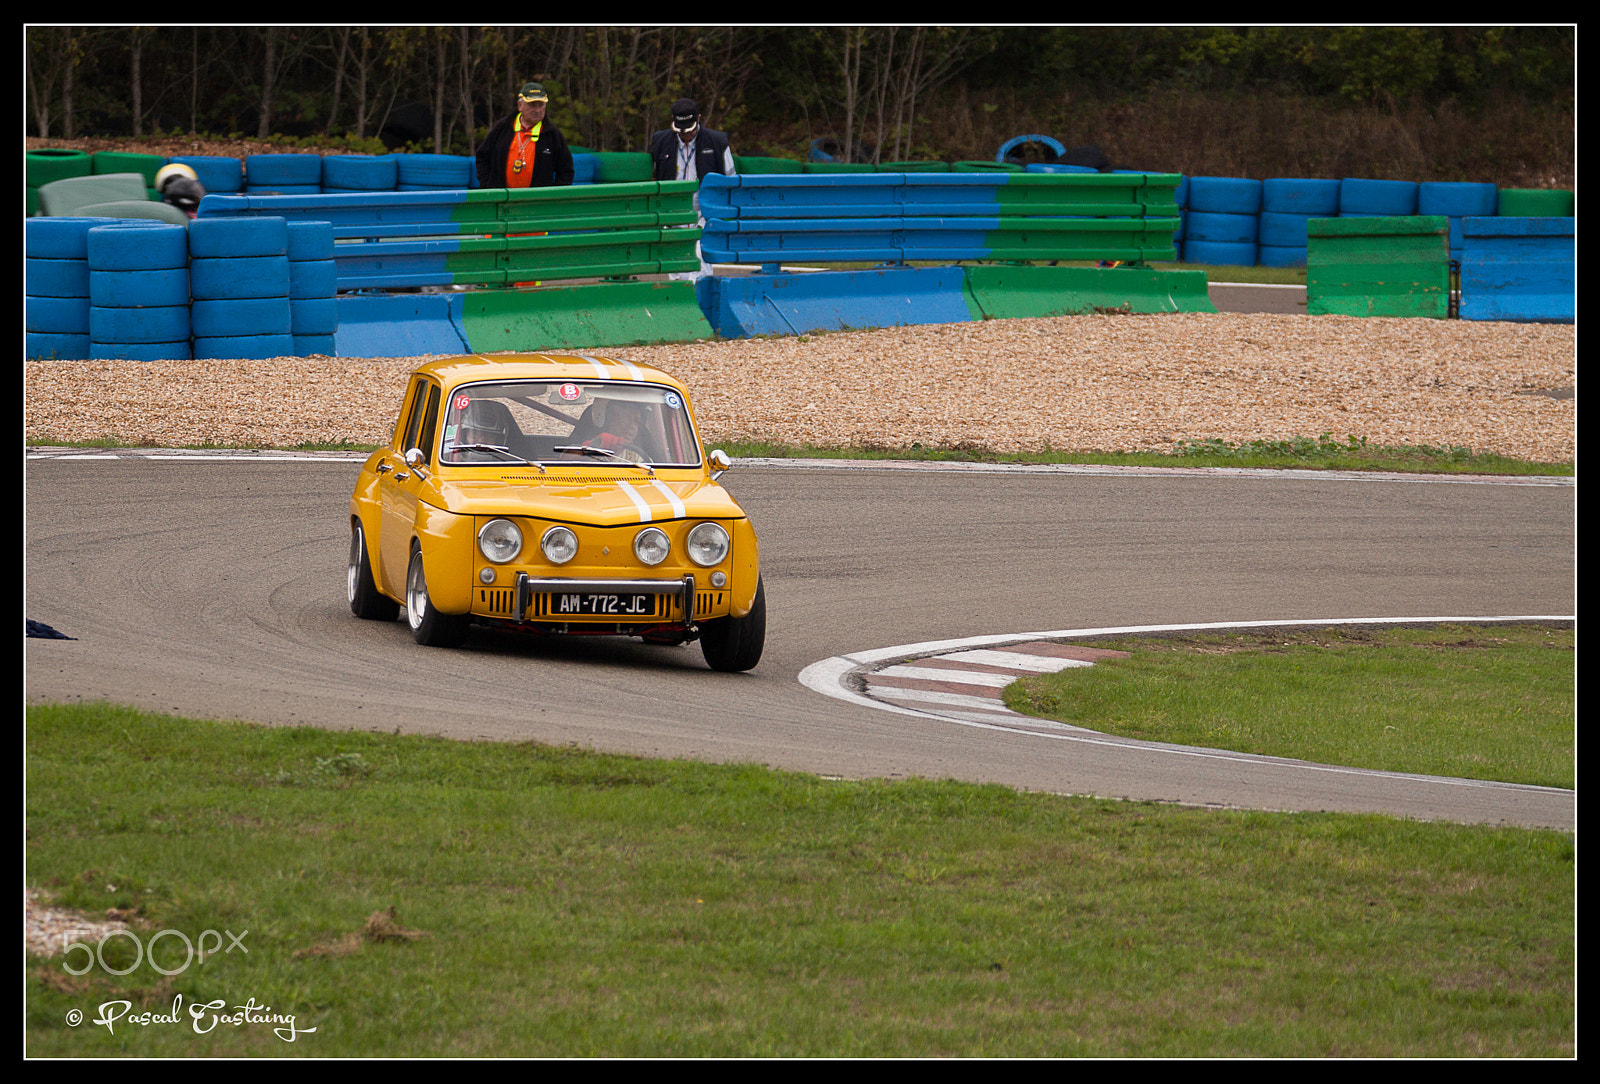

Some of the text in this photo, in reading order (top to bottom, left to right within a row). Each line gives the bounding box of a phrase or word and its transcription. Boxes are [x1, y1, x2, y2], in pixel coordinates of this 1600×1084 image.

[565, 385, 577, 395] B
[456, 397, 469, 407] 16
[560, 594, 646, 613] AM-772-JC
